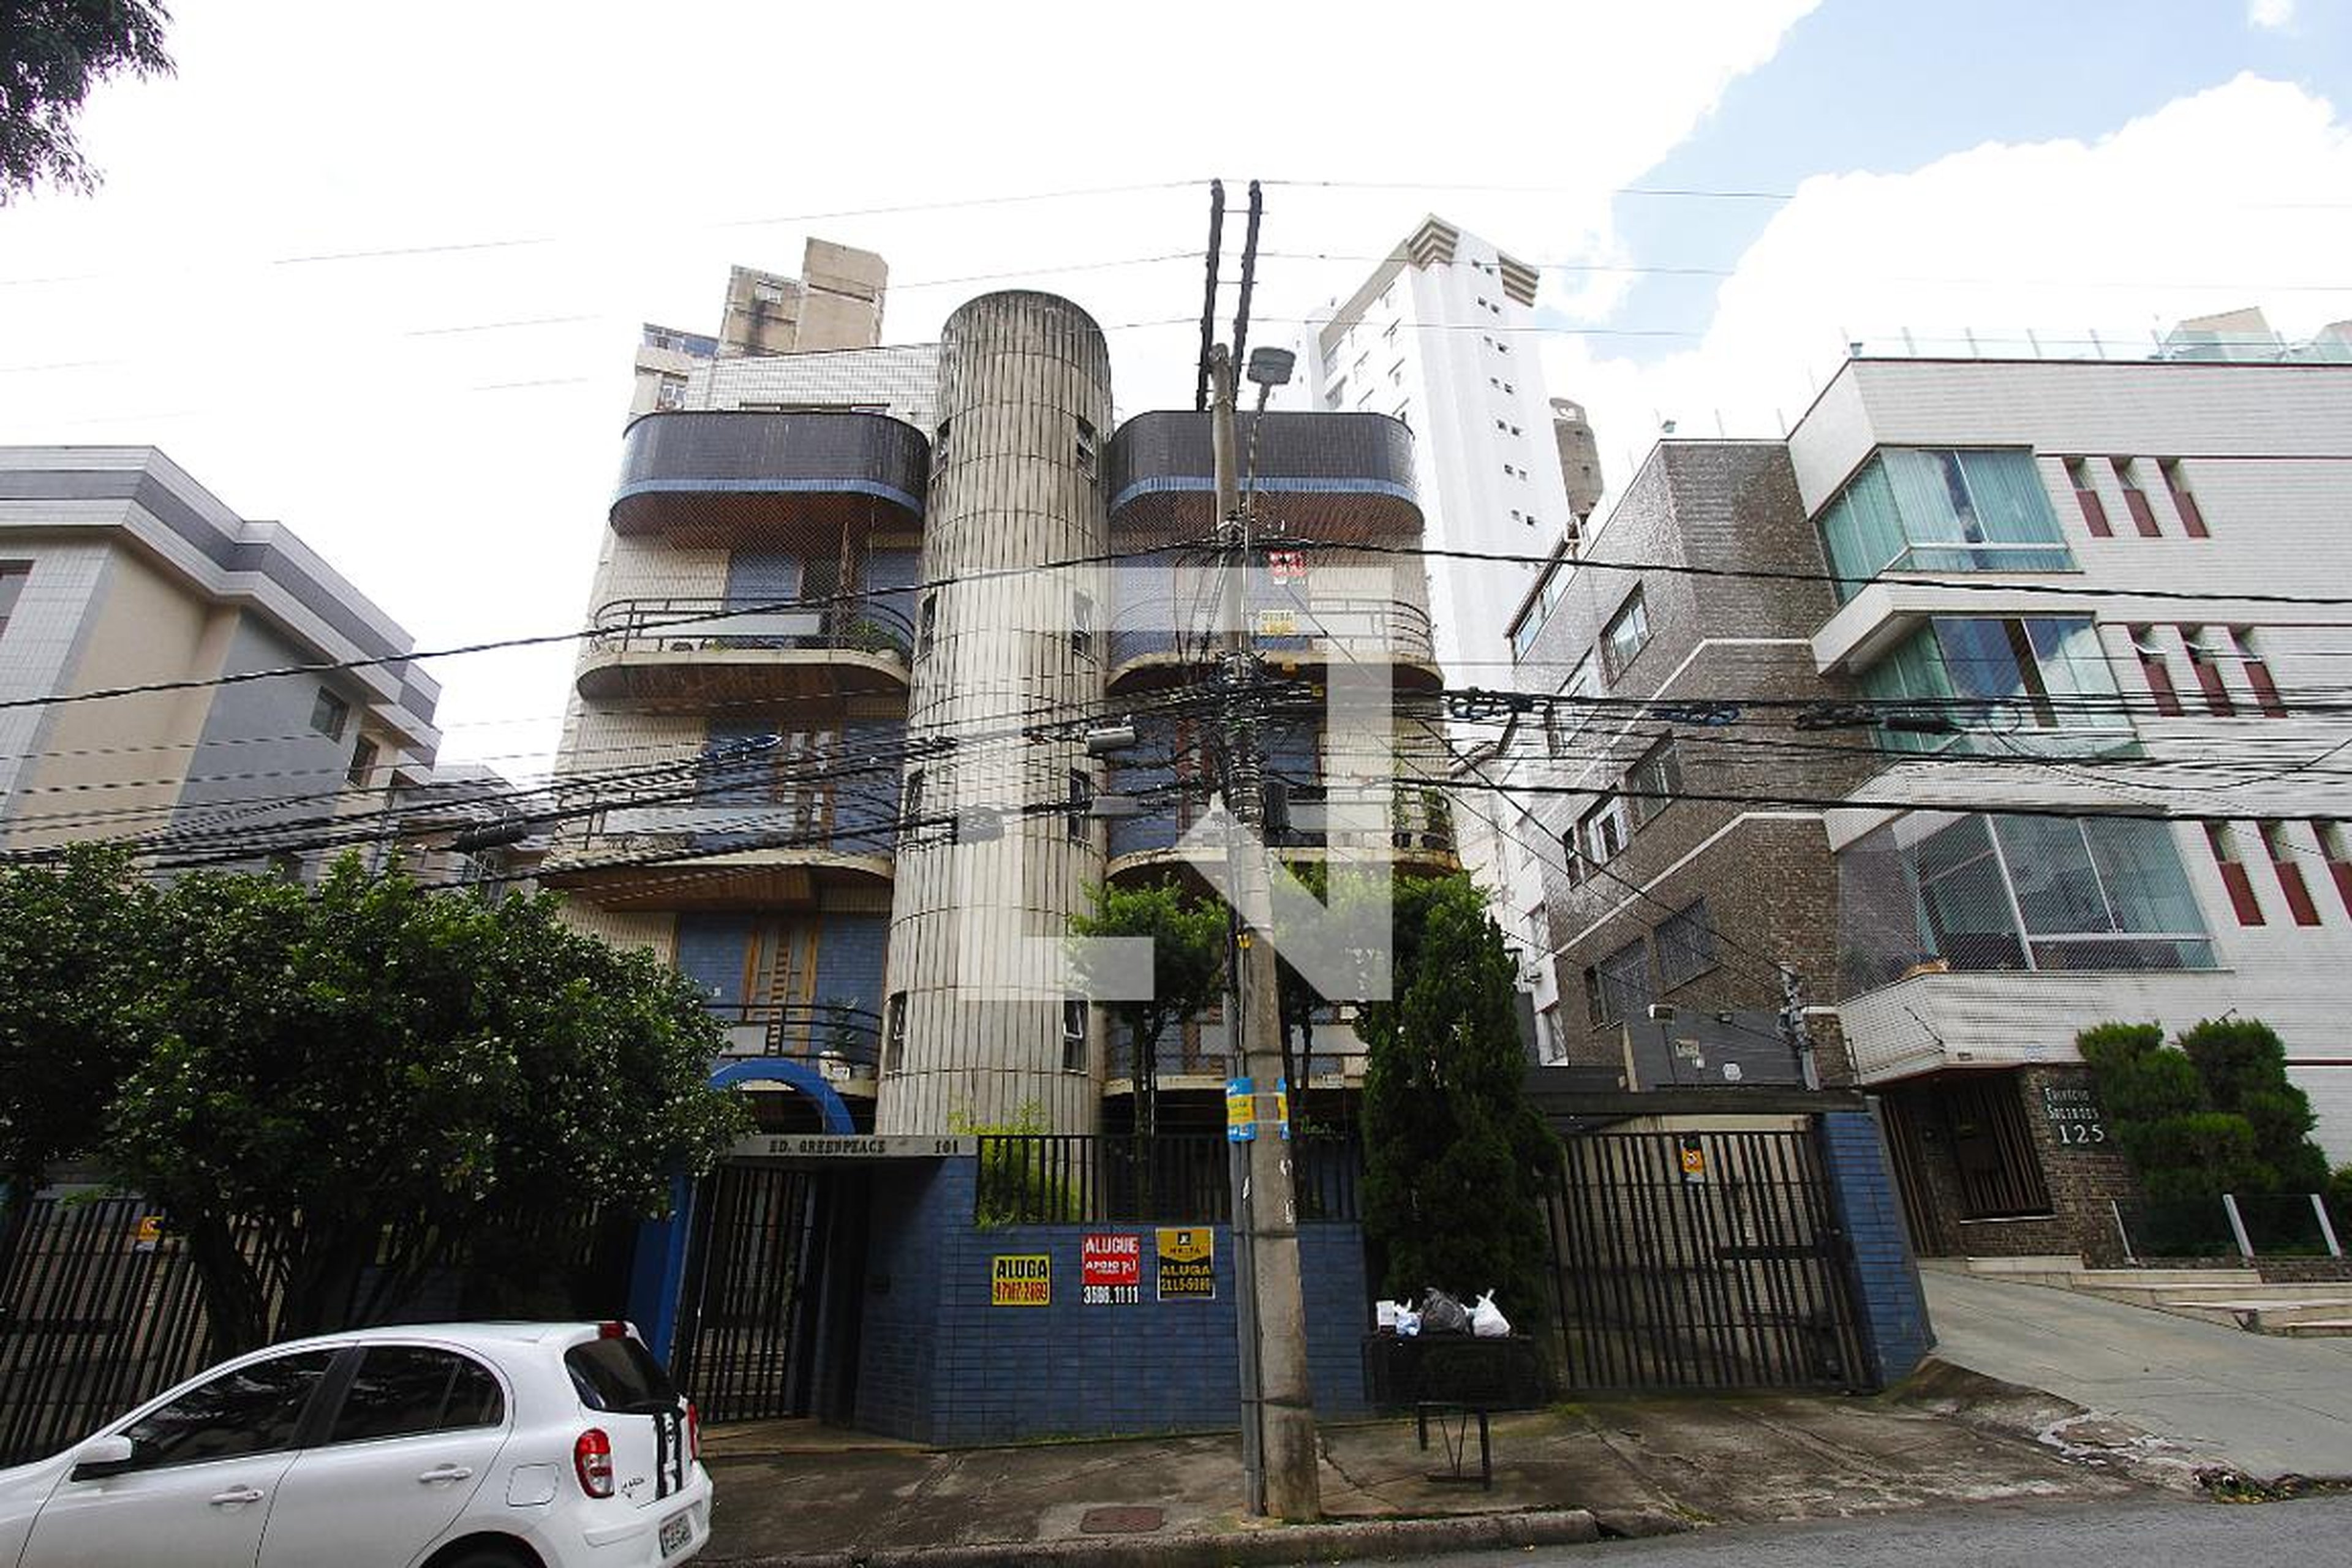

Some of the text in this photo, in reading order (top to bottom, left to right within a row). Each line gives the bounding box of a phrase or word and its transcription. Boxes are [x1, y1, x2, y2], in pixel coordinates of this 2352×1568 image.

[2059, 1124, 2105, 1144] 125
[799, 1139, 886, 1154] GREENPEACE
[1086, 1236, 1139, 1254] ALUGUE
[997, 1259, 1047, 1279] ALUGA
[1161, 1265, 1211, 1276] ALUGA
